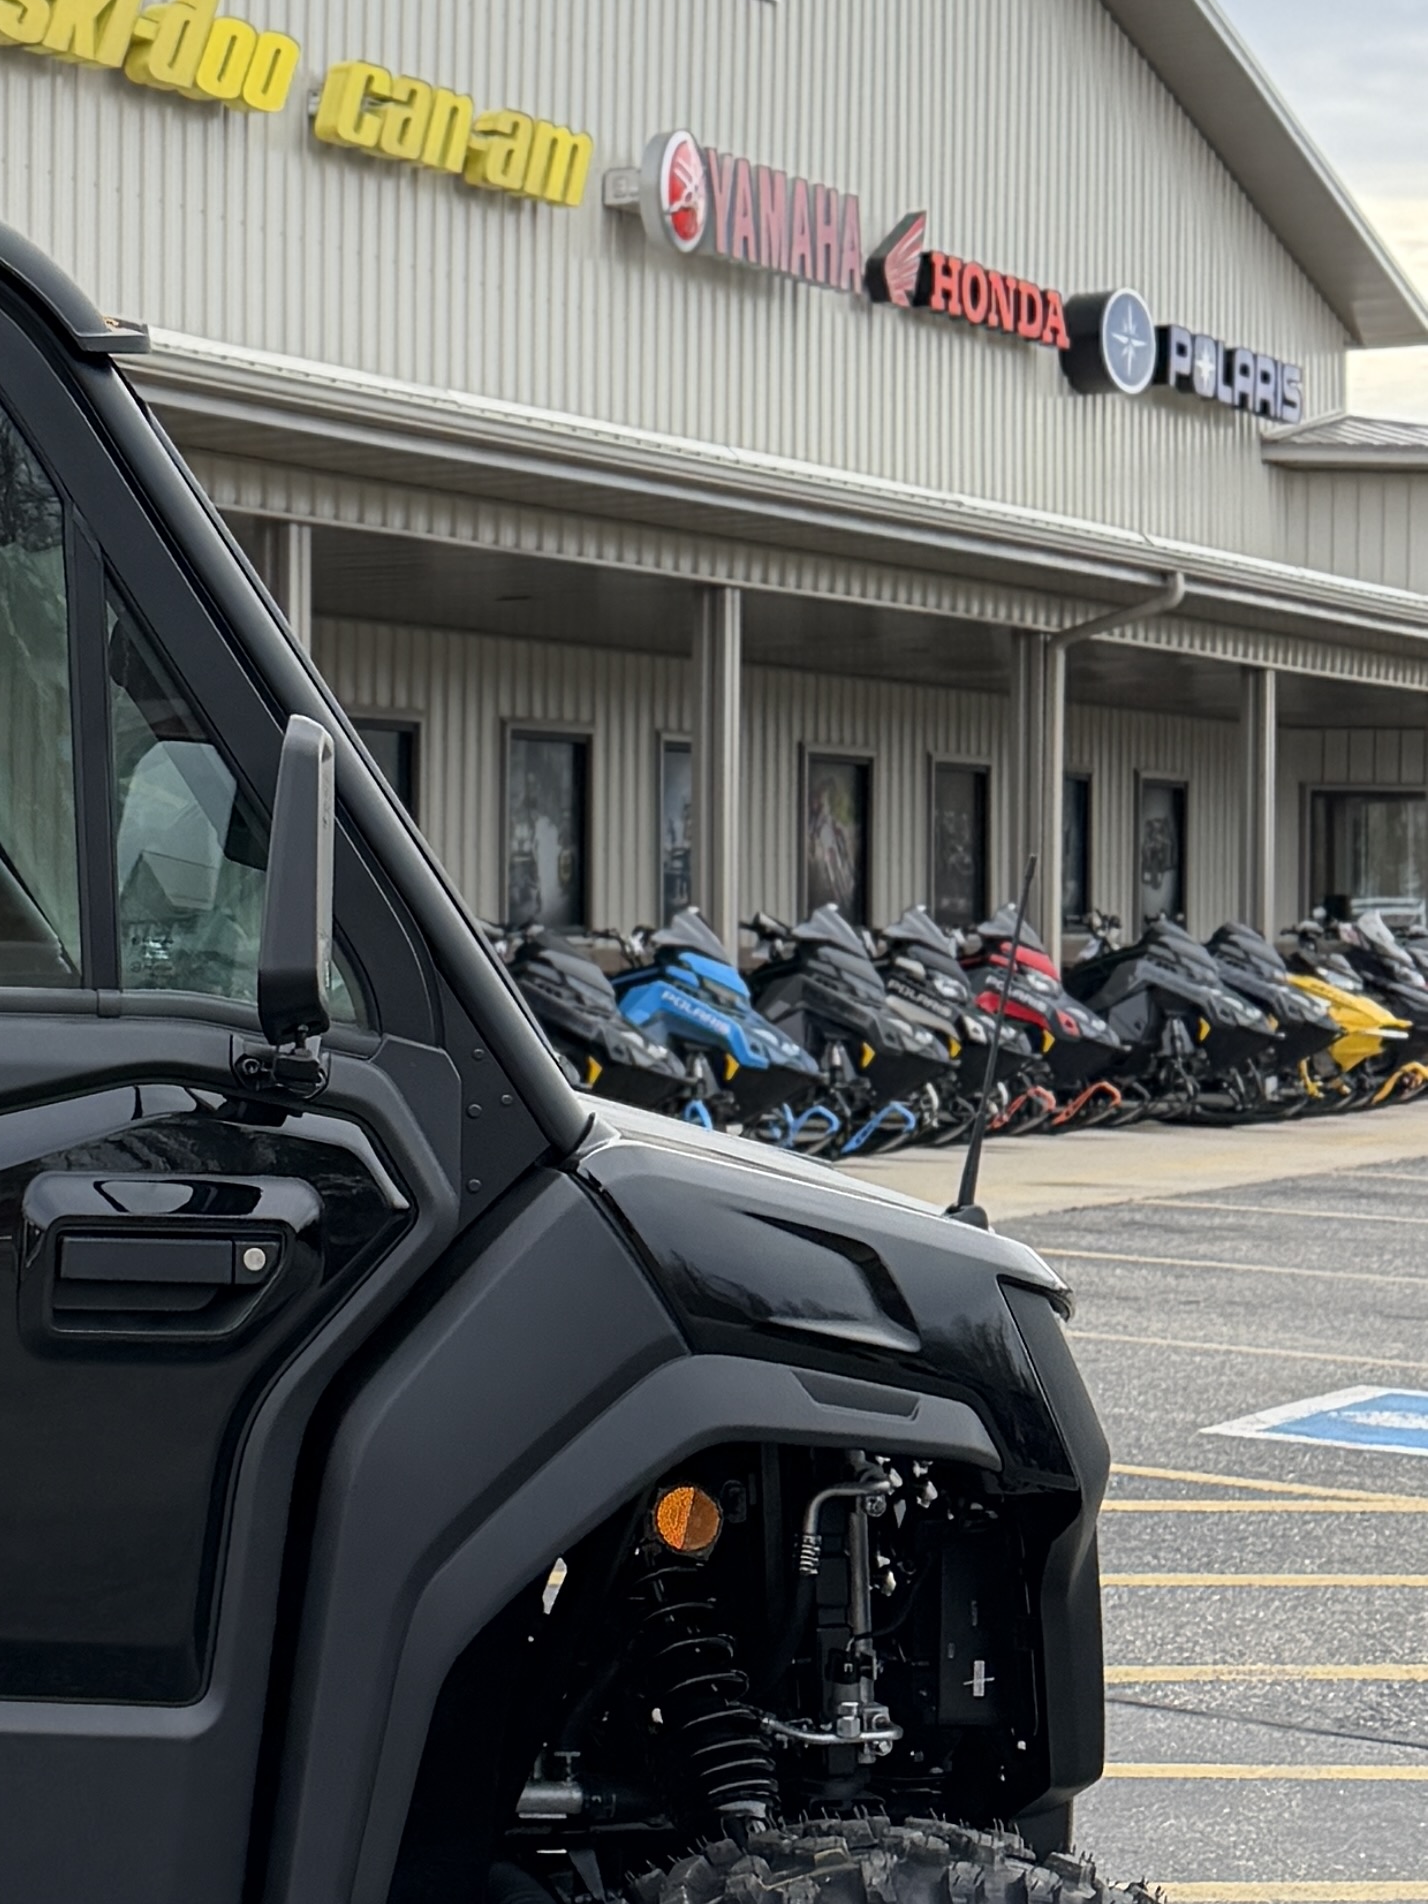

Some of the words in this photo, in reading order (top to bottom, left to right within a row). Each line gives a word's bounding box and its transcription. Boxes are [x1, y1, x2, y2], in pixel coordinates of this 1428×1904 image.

[707, 148, 864, 295] YAMAHA
[930, 253, 1070, 350] HONDA
[1168, 324, 1304, 424] POLARIS
[661, 990, 731, 1037] POLARIS
[887, 979, 952, 1018] POLARIS
